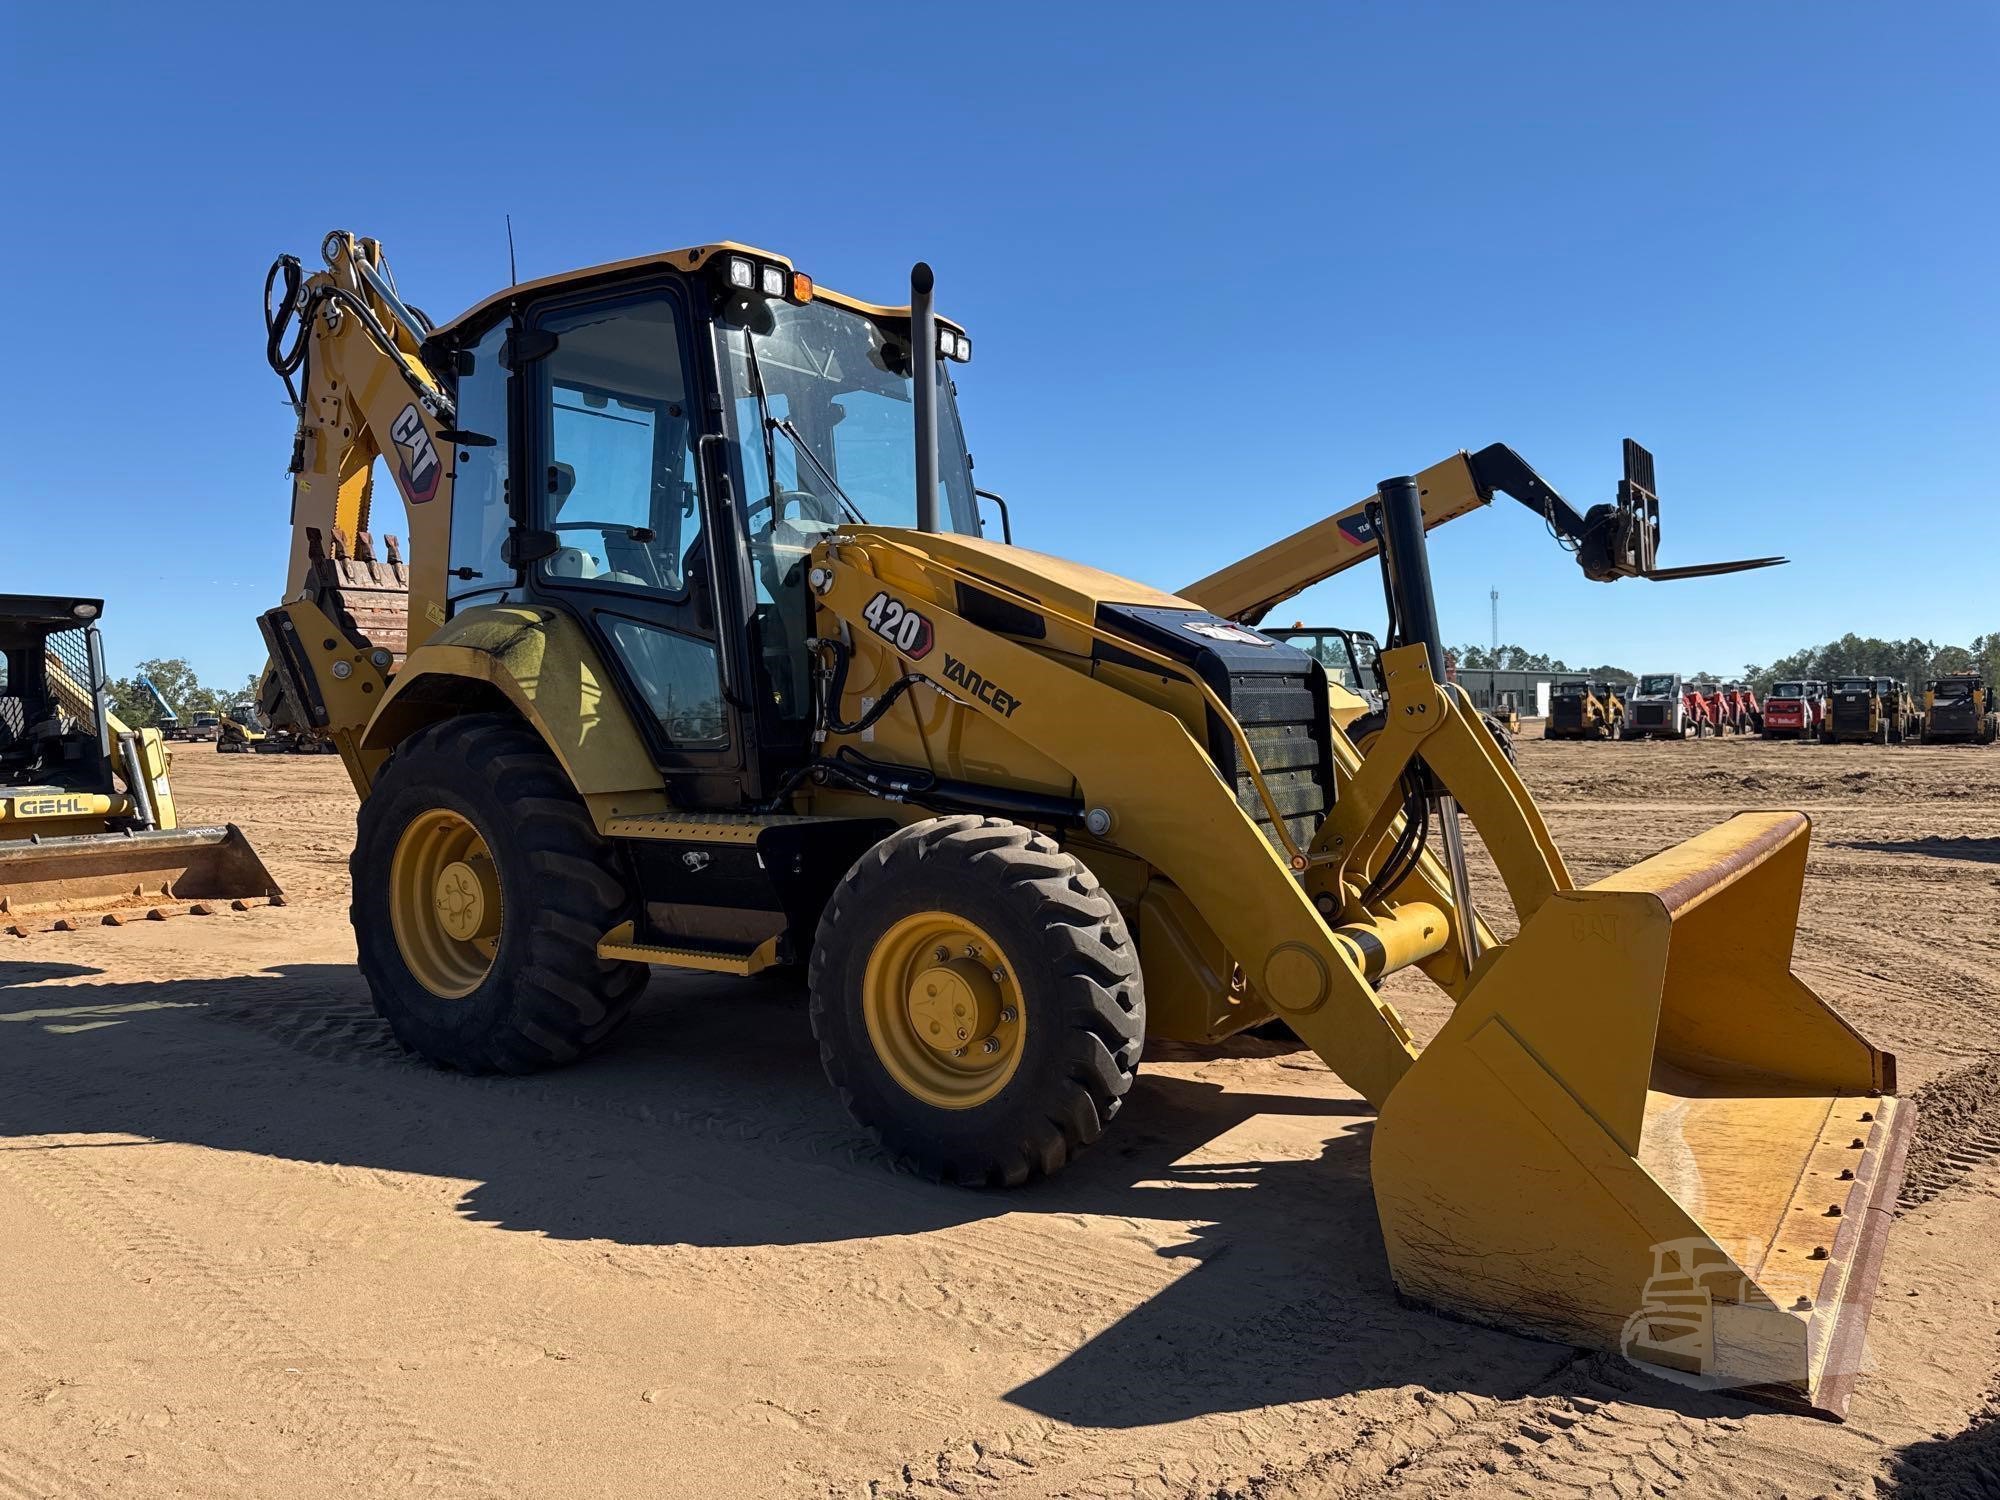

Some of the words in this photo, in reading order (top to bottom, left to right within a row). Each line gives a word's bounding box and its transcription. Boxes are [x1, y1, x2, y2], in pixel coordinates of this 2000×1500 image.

[391, 404, 439, 483] CAT
[863, 592, 921, 651] 420
[942, 652, 1022, 719] YANCEY
